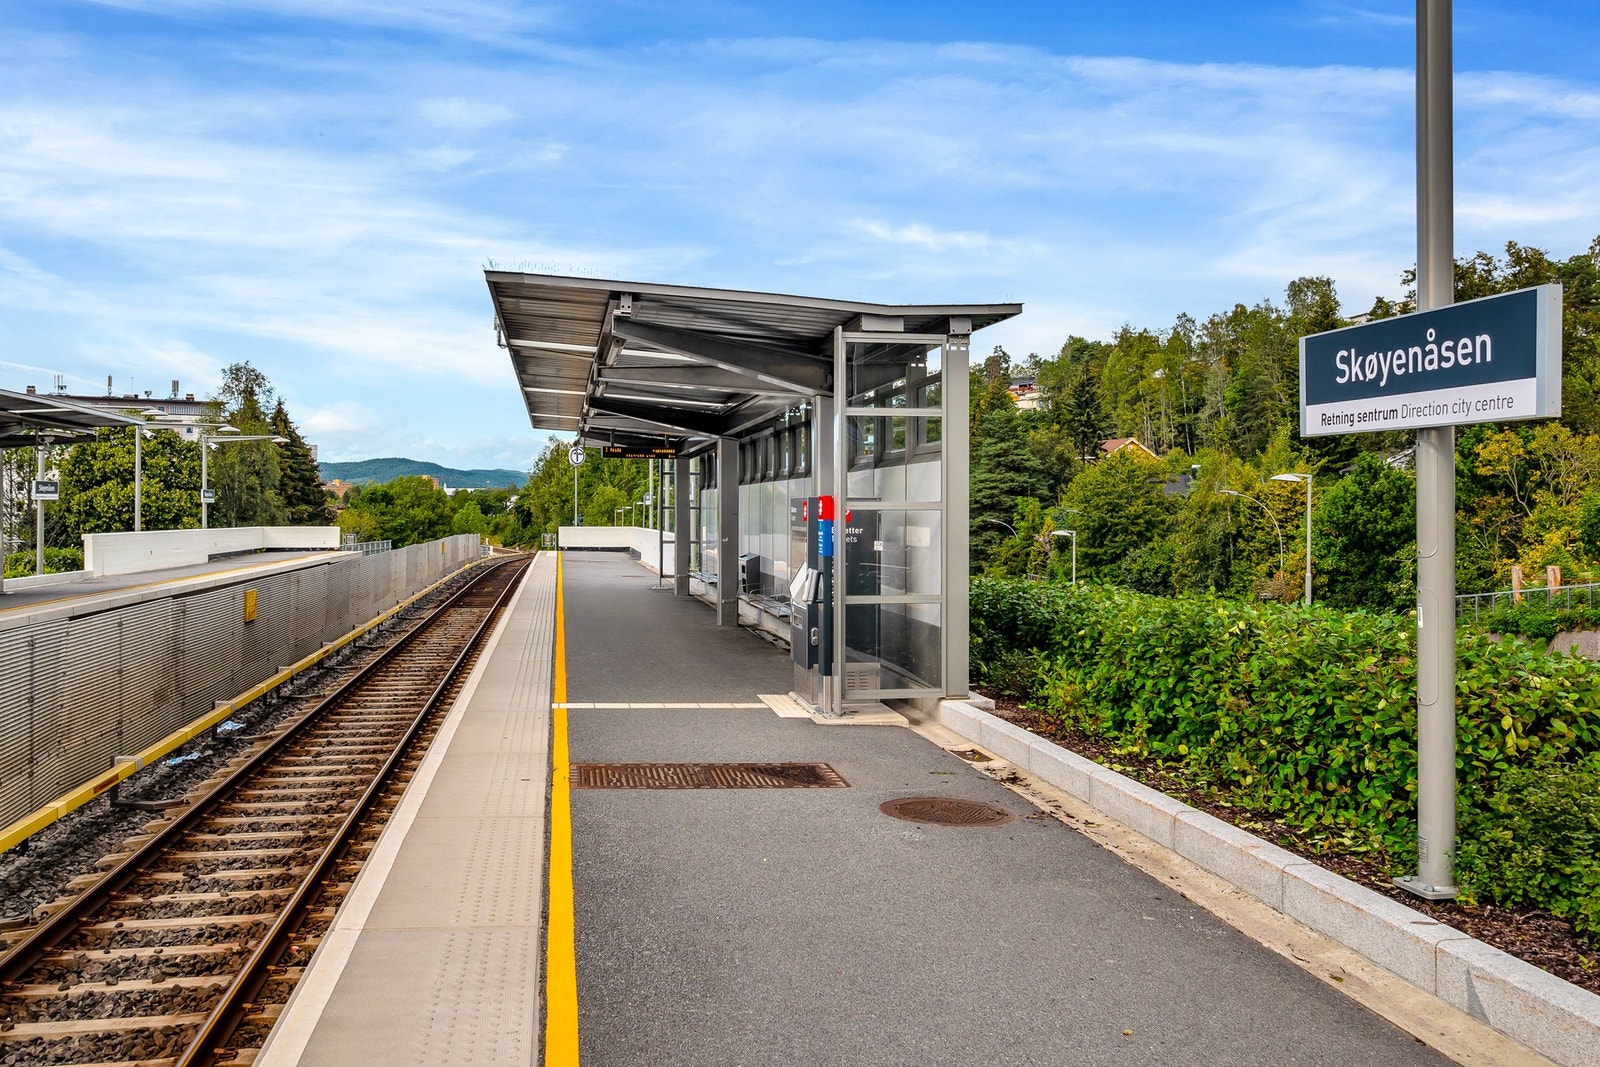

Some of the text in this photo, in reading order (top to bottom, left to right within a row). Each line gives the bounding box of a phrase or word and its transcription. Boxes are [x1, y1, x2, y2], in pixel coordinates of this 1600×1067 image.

[1335, 328, 1492, 387] Skøyenåsen
[1320, 395, 1514, 427] Retning sentrum Direction city centre
